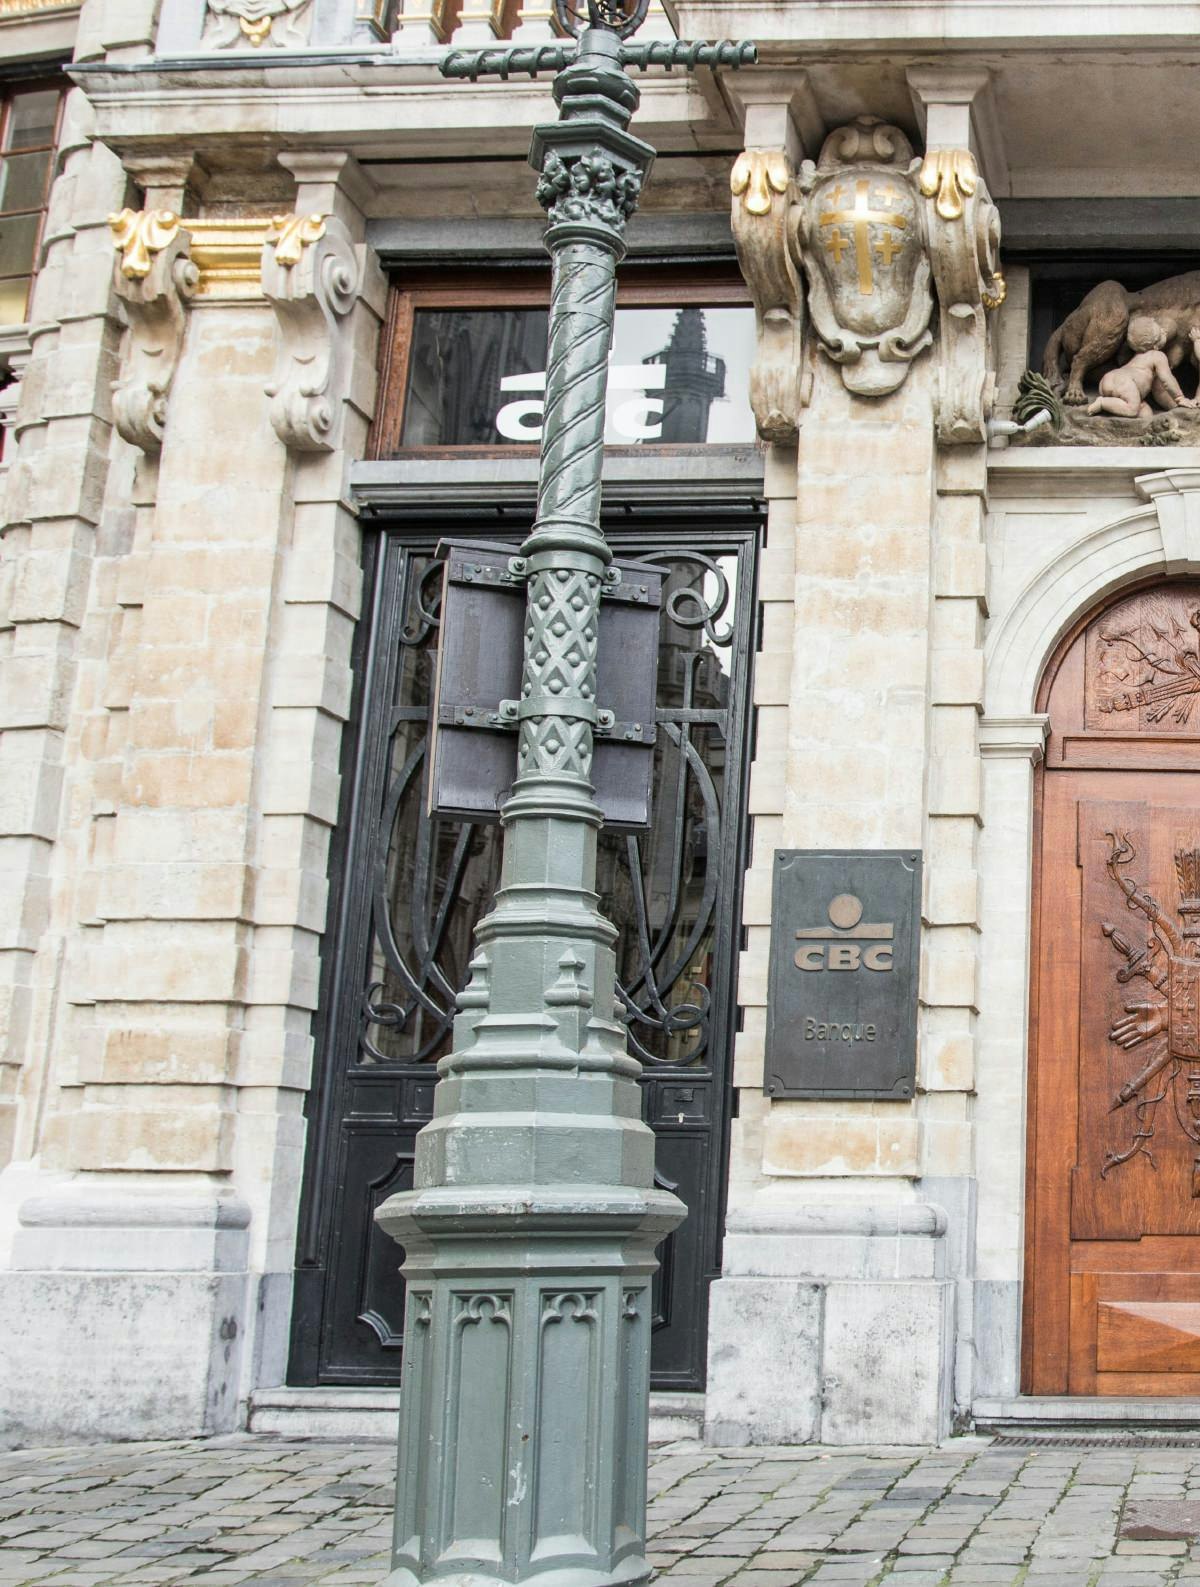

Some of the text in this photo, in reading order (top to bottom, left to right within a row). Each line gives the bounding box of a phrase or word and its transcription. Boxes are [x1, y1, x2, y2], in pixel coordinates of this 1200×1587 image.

[496, 399, 663, 440] CC
[794, 944, 893, 971] CBC
[804, 1017, 876, 1047] Banque
